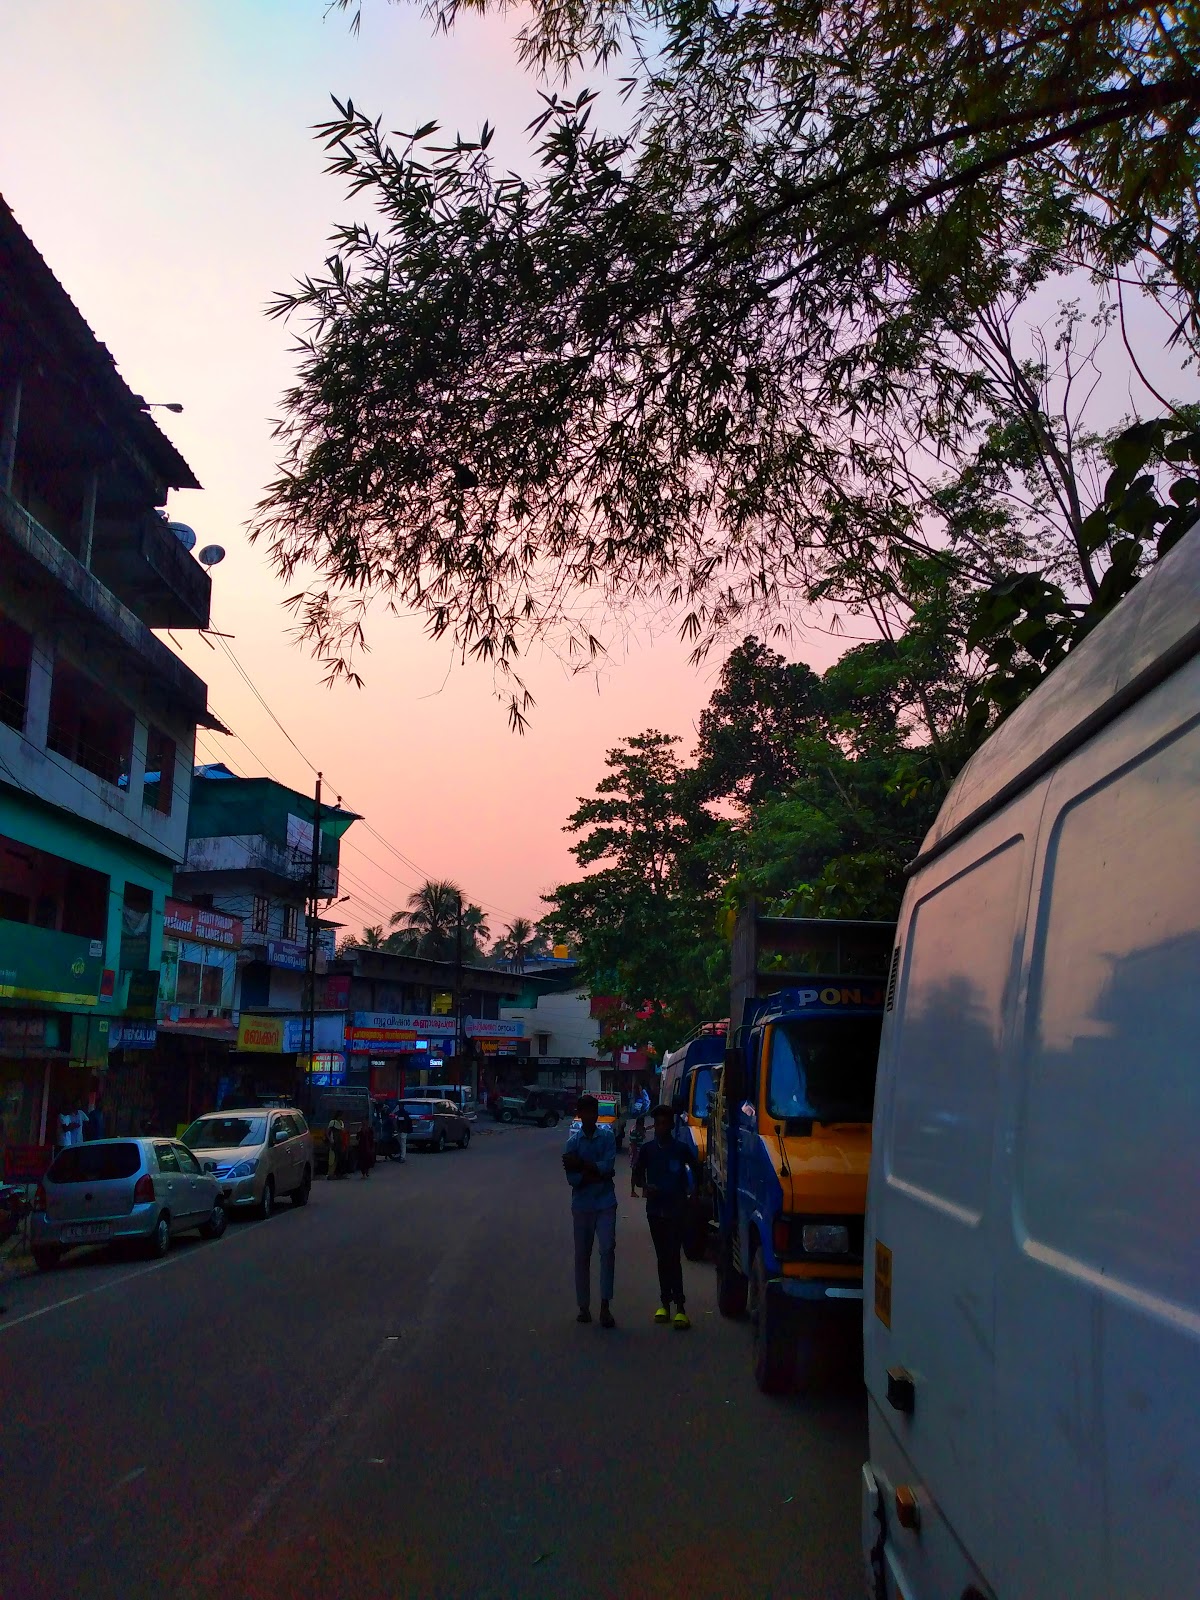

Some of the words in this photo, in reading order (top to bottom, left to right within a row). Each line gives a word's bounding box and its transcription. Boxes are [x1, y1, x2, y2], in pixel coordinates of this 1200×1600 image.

[195, 924, 205, 938] FOR
[204, 927, 220, 942] LADIES
[224, 932, 234, 945] KIDS
[146, 1029, 158, 1042] LAB
